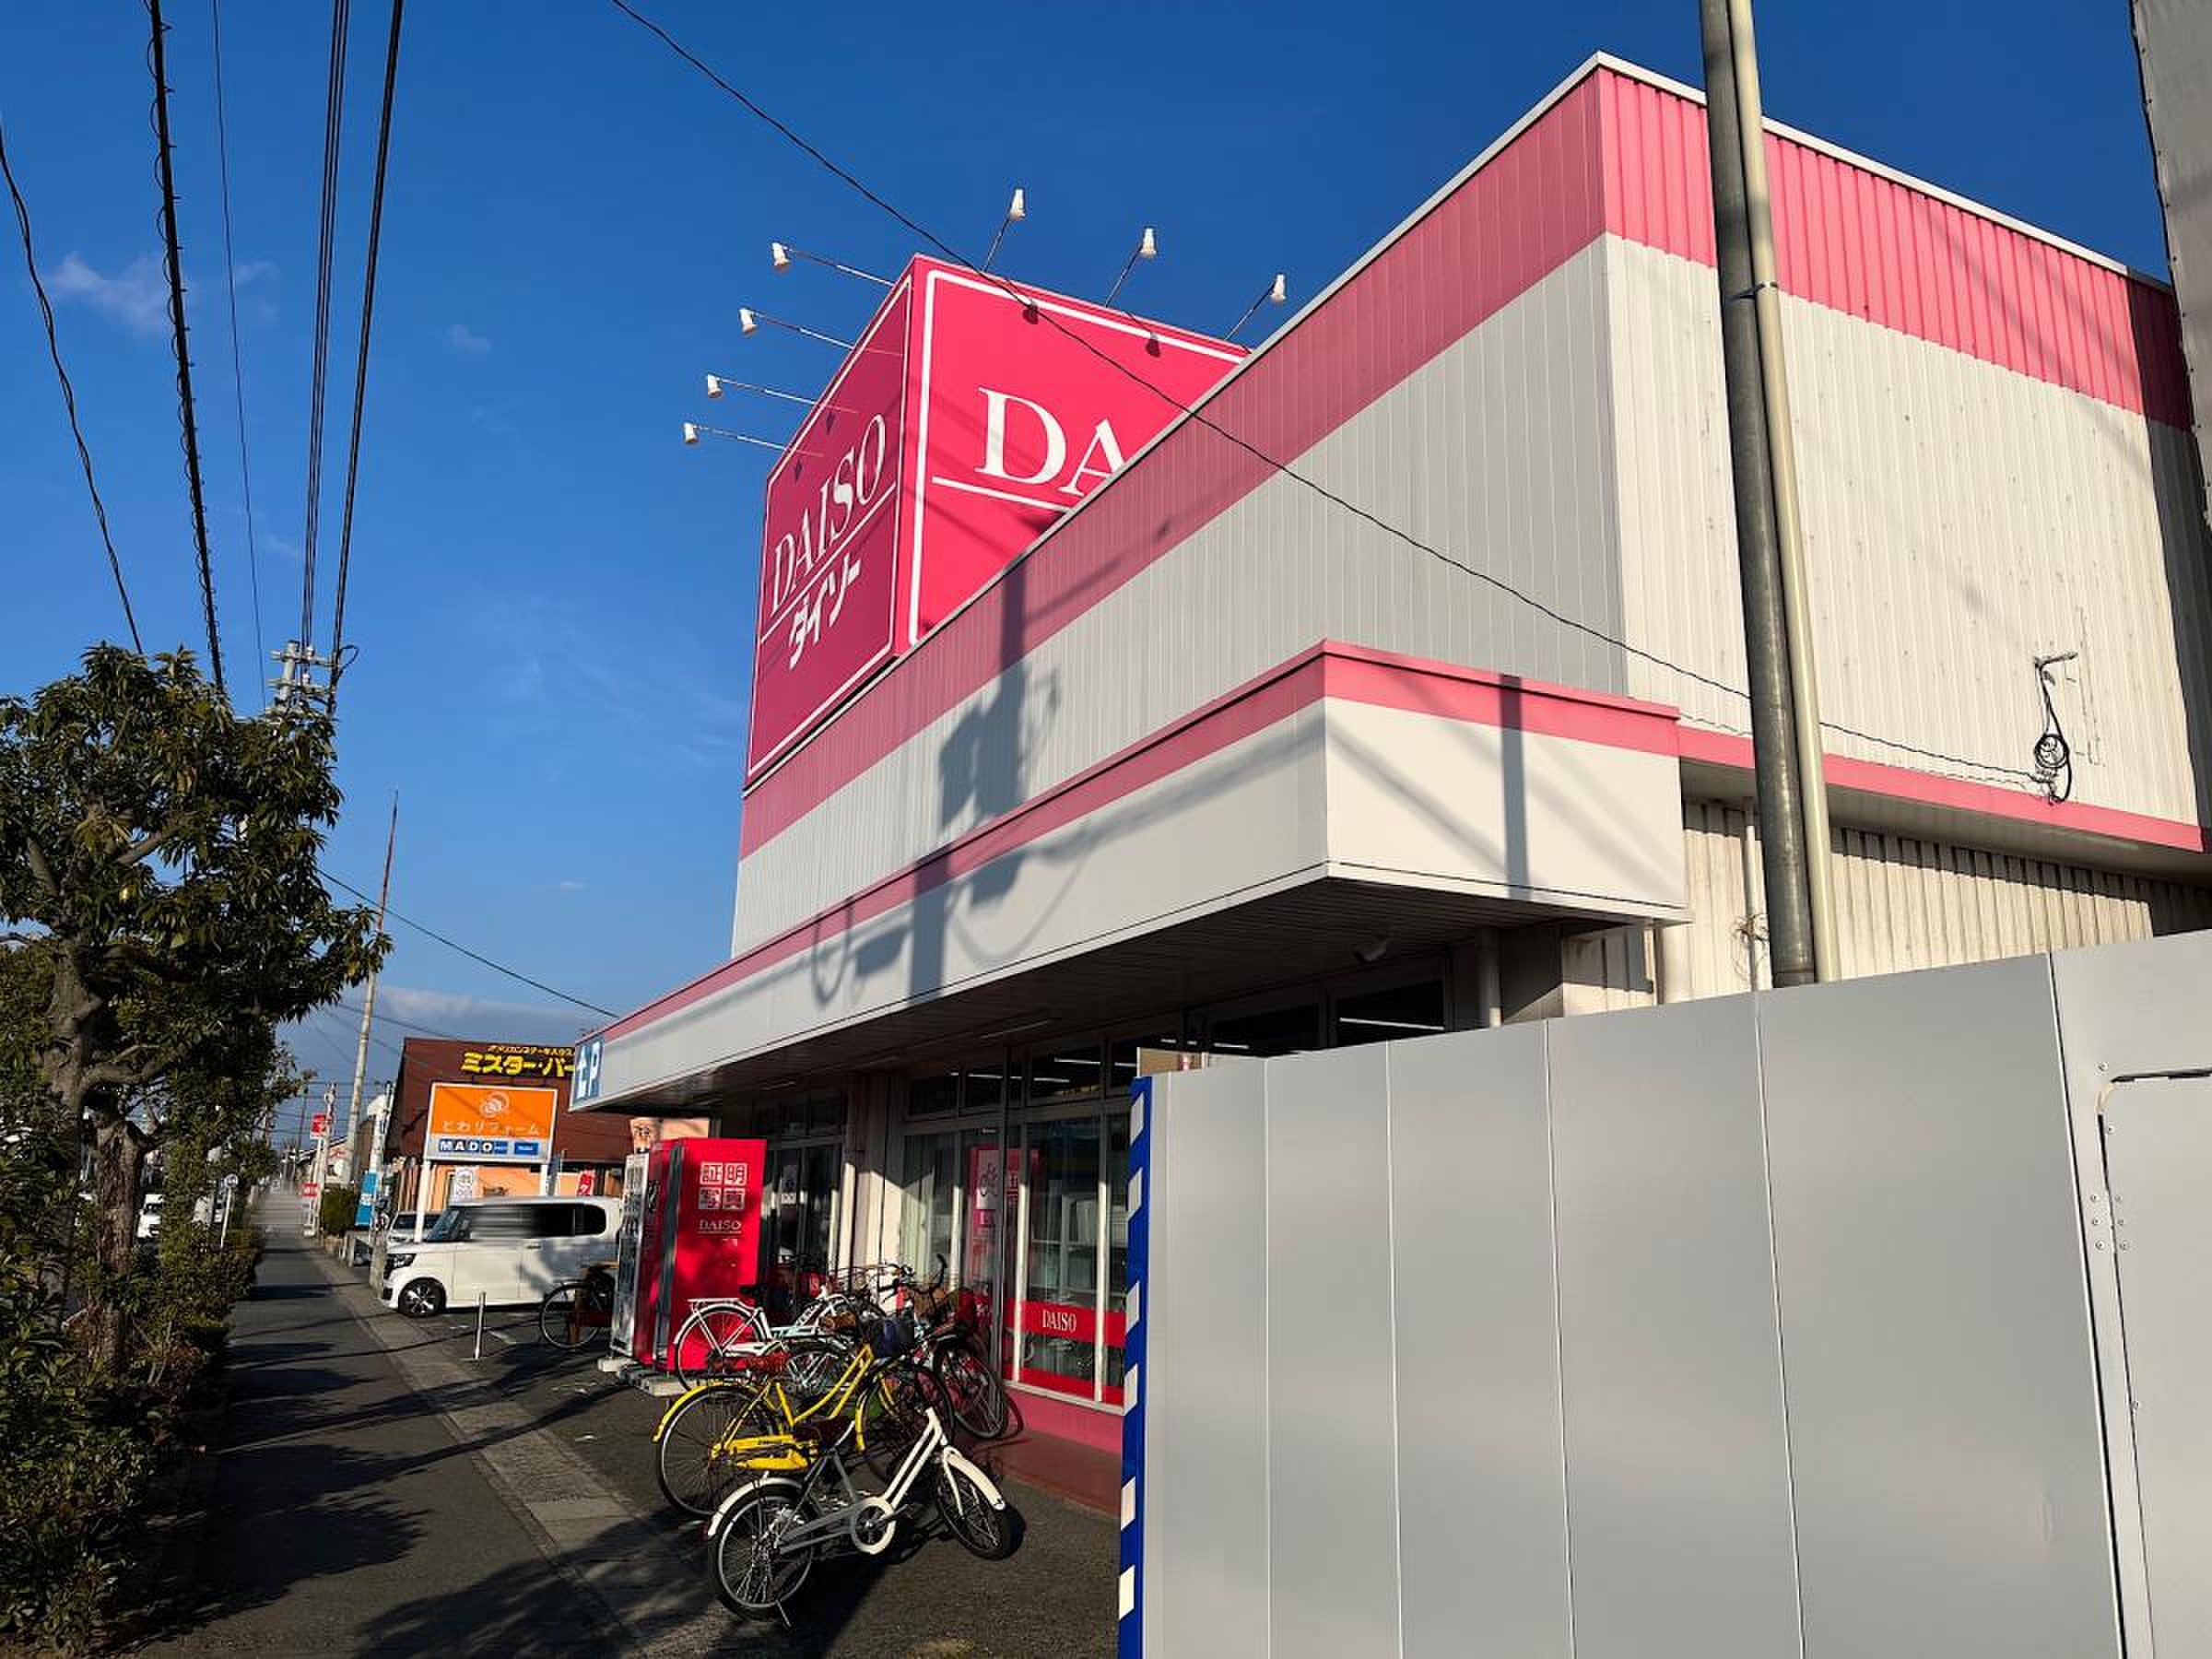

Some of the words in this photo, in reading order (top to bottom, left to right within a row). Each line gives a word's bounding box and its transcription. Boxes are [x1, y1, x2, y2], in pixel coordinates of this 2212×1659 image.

[770, 414, 886, 618] DAISO
[788, 553, 862, 670] ダイソー
[440, 1139, 493, 1153] MADO
[700, 1218, 742, 1230] DAISO
[1042, 1309, 1077, 1334] DAISO
